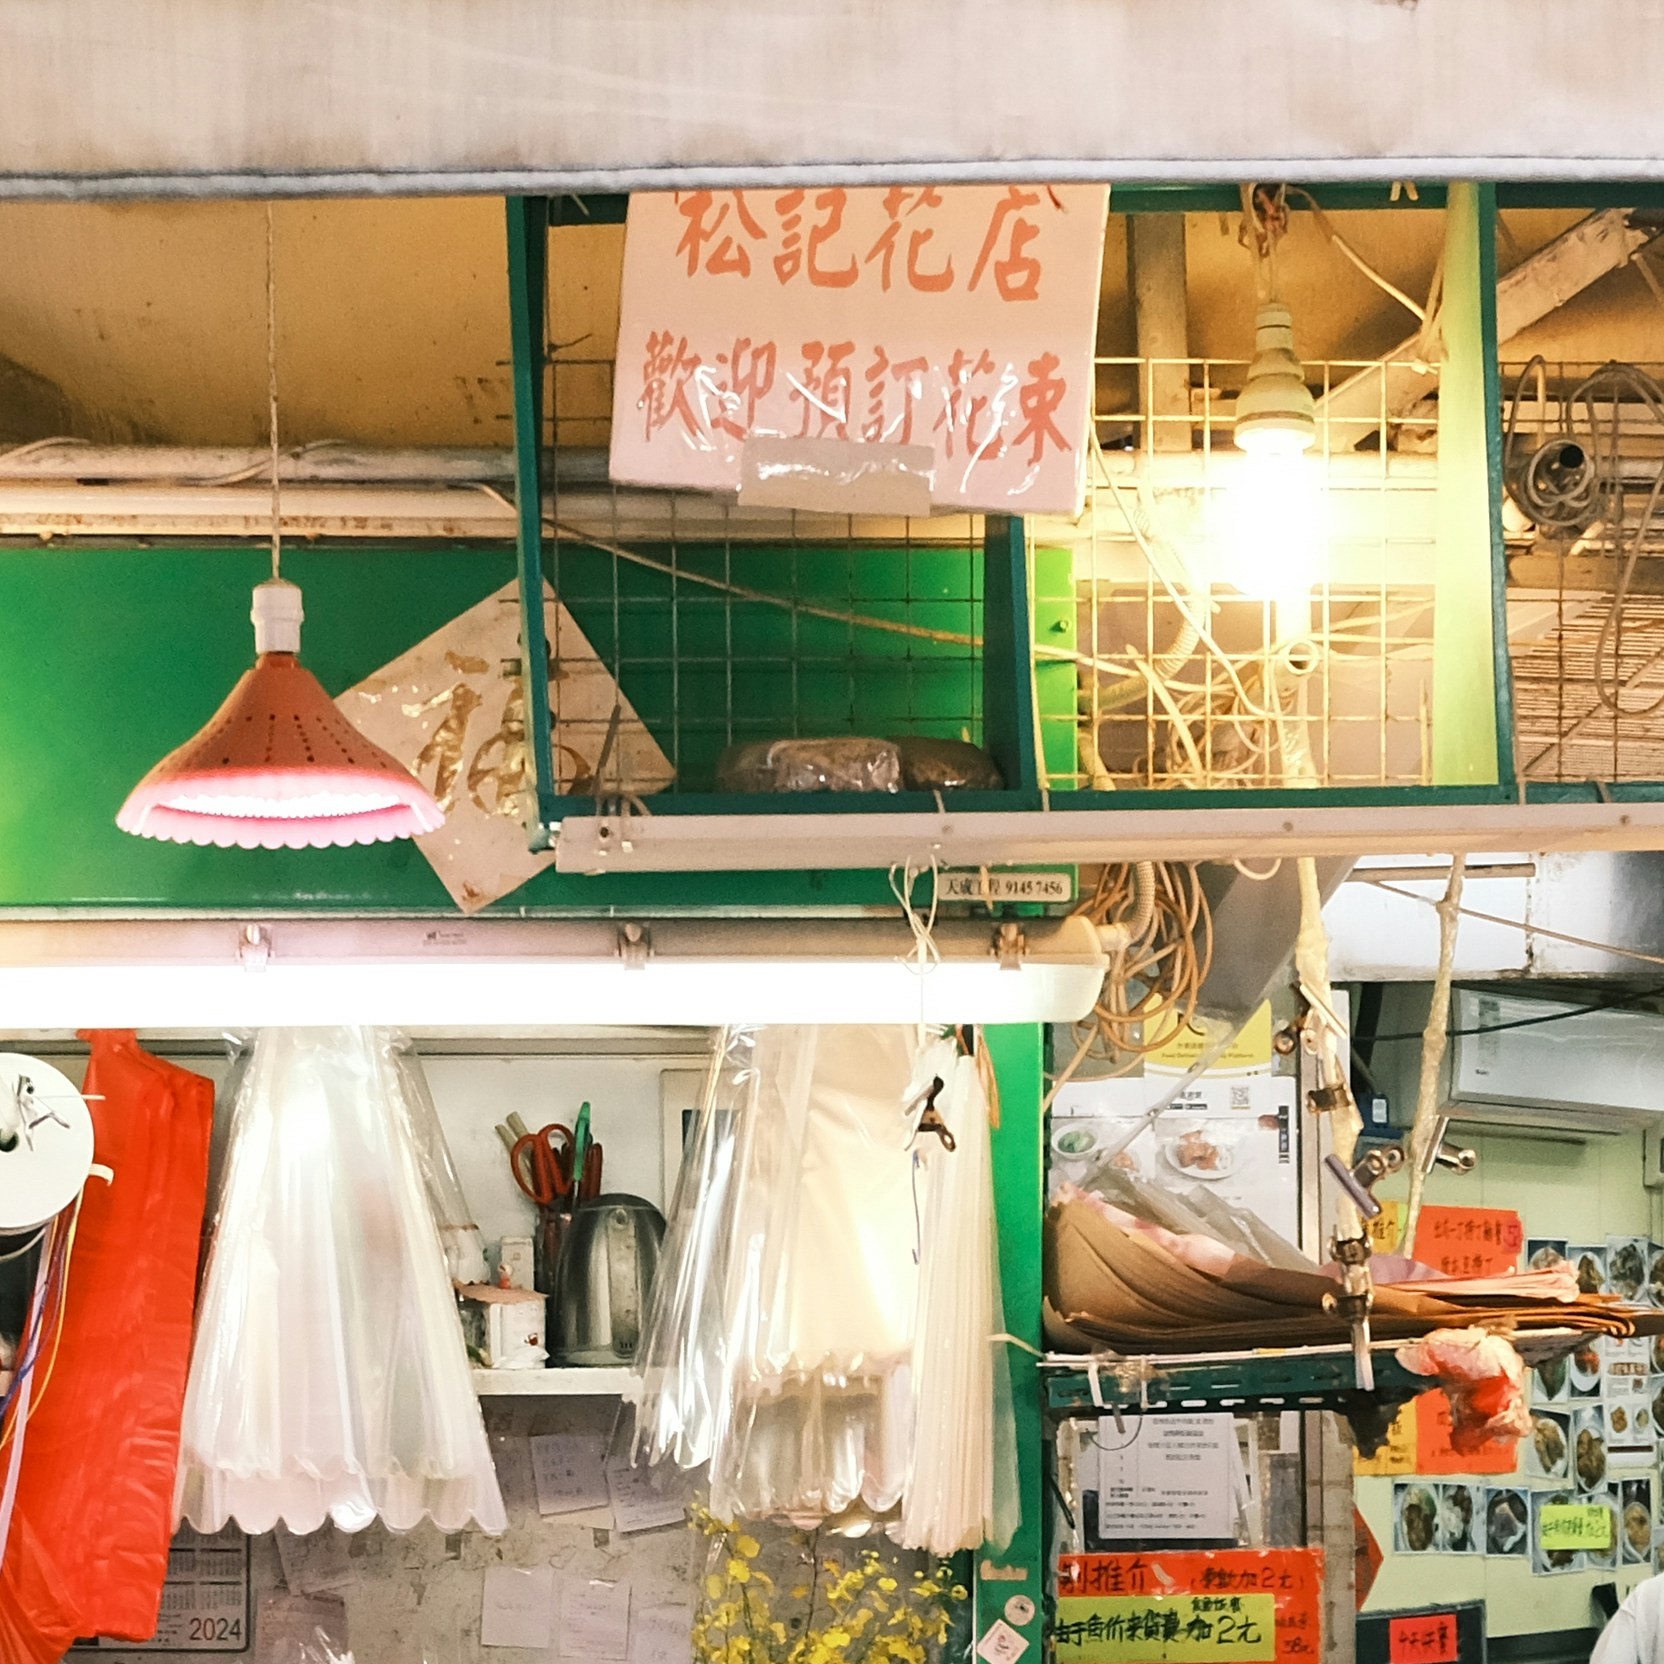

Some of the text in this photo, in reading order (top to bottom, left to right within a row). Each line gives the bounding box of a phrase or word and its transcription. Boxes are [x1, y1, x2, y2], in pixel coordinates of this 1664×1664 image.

[675, 188, 1041, 302] 松記花店
[638, 331, 1072, 466] 歡迎預訂花束
[1005, 880, 1033, 896] 9145
[1035, 880, 1063, 896] 7456
[188, 1616, 243, 1641] 2024
